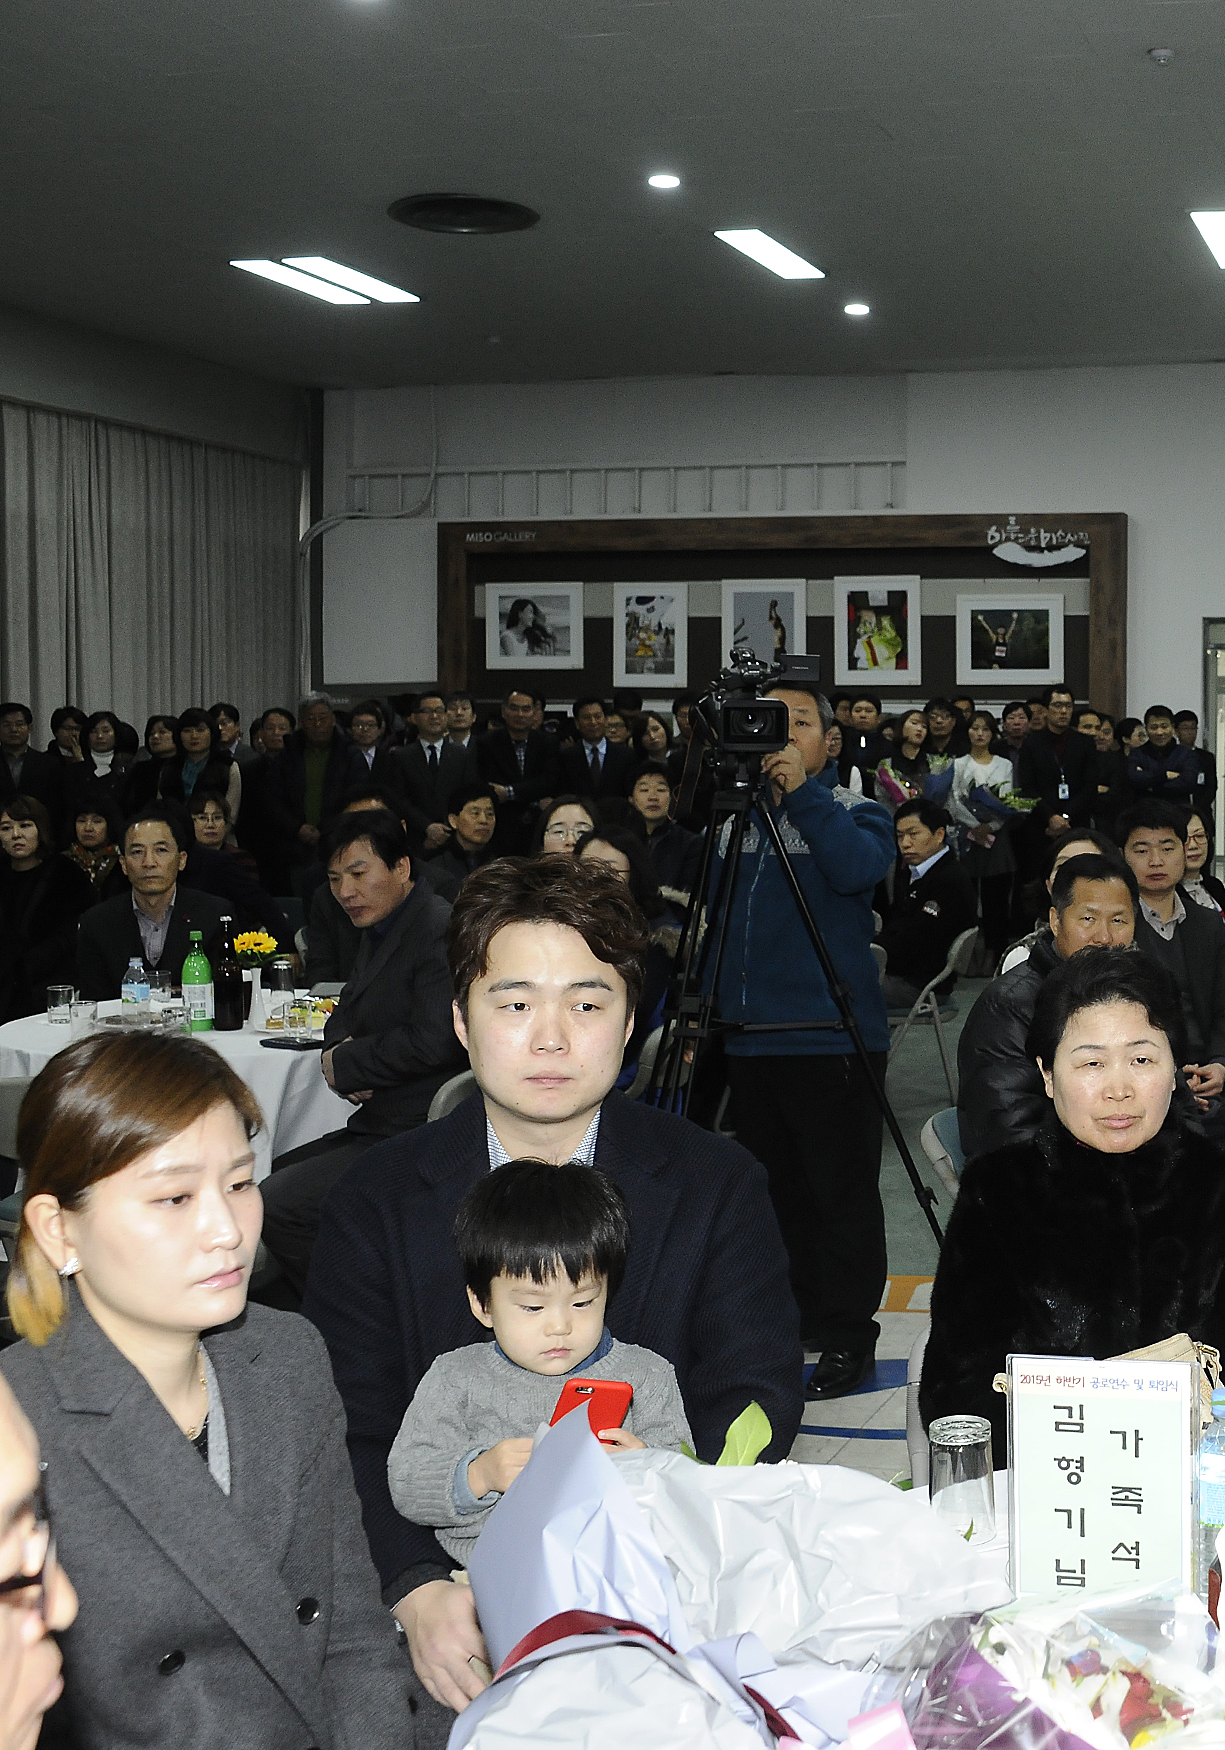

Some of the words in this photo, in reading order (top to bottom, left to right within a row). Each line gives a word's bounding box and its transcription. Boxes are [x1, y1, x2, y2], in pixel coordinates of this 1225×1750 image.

[466, 532, 493, 542] MISO
[494, 531, 537, 542] GALLERY
[1020, 1374, 1051, 1387] 2015년
[1055, 1375, 1085, 1388] 하반기
[1089, 1376, 1130, 1390] 공로연수
[1133, 1378, 1144, 1391] 및
[1148, 1379, 1178, 1392] 퇴임식
[1053, 1404, 1086, 1588] 김형기님
[1109, 1429, 1144, 1570] 가족석
